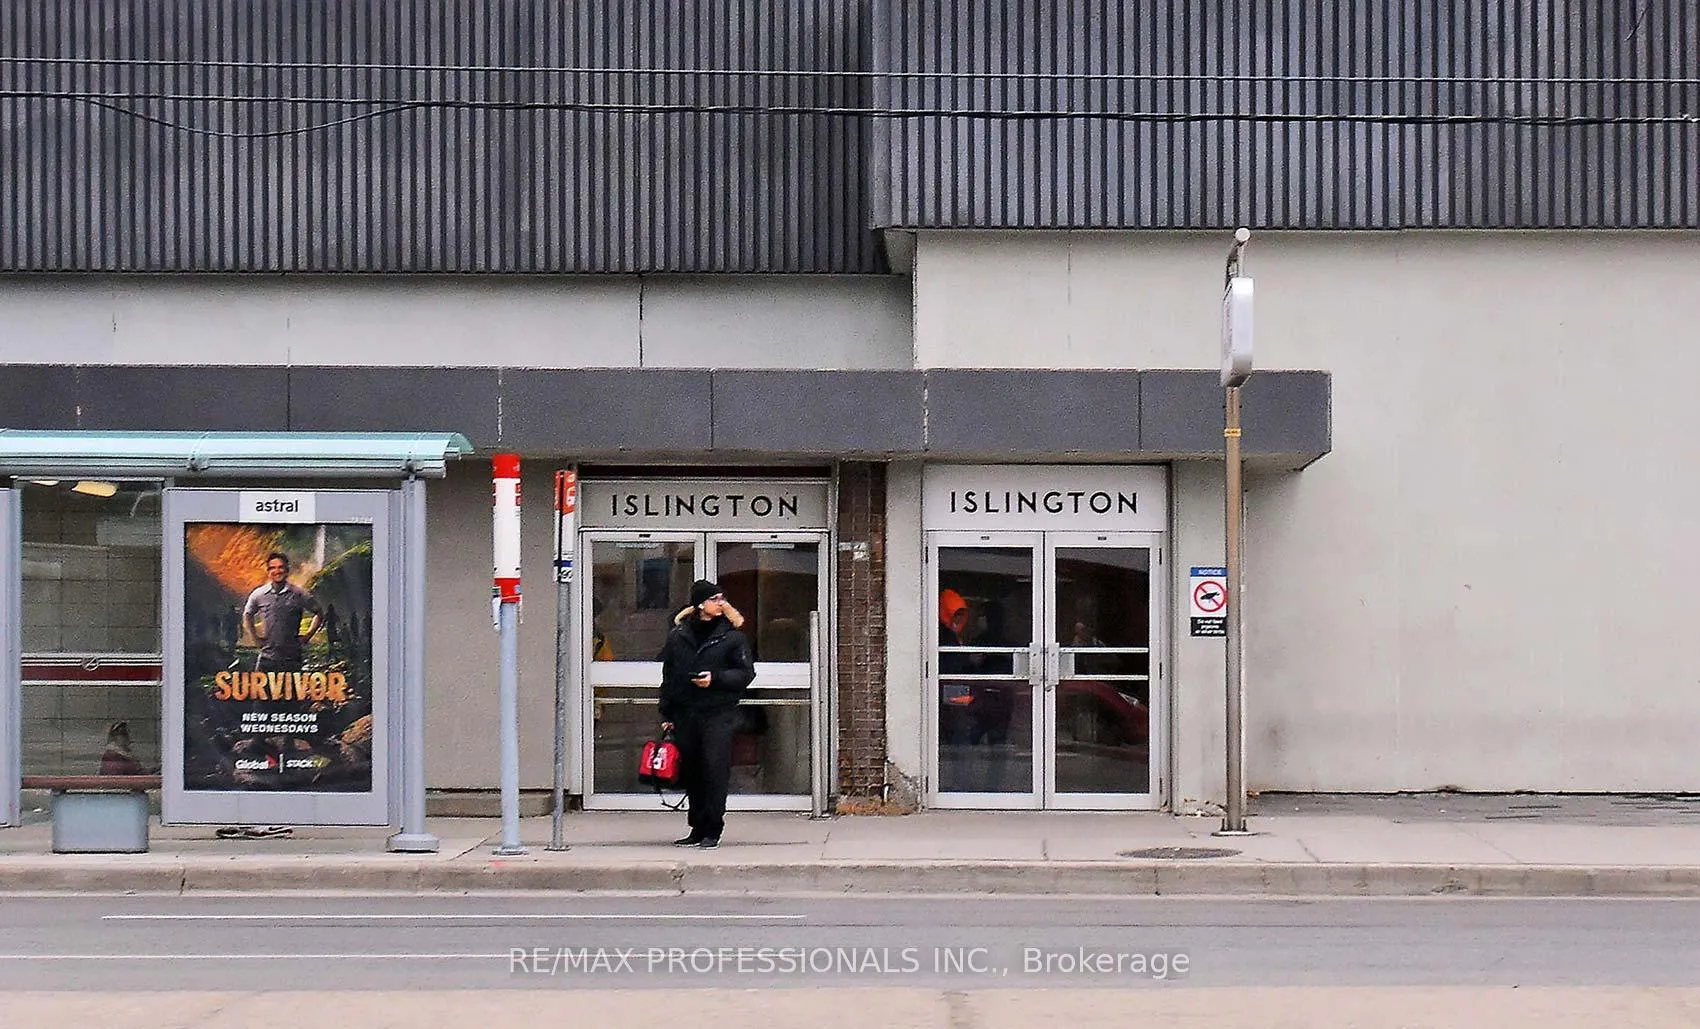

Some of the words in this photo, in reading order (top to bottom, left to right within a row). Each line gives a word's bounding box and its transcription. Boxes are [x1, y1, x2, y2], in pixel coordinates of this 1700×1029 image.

[255, 499, 299, 513] astral
[612, 494, 798, 517] ISLINGTON
[951, 491, 1138, 514] ISLINGTON
[214, 671, 347, 703] SURVIVOR
[242, 713, 269, 722] NEW
[270, 713, 318, 722] SEASON
[240, 724, 319, 733] WEDNESDAYS
[235, 759, 270, 770] Global
